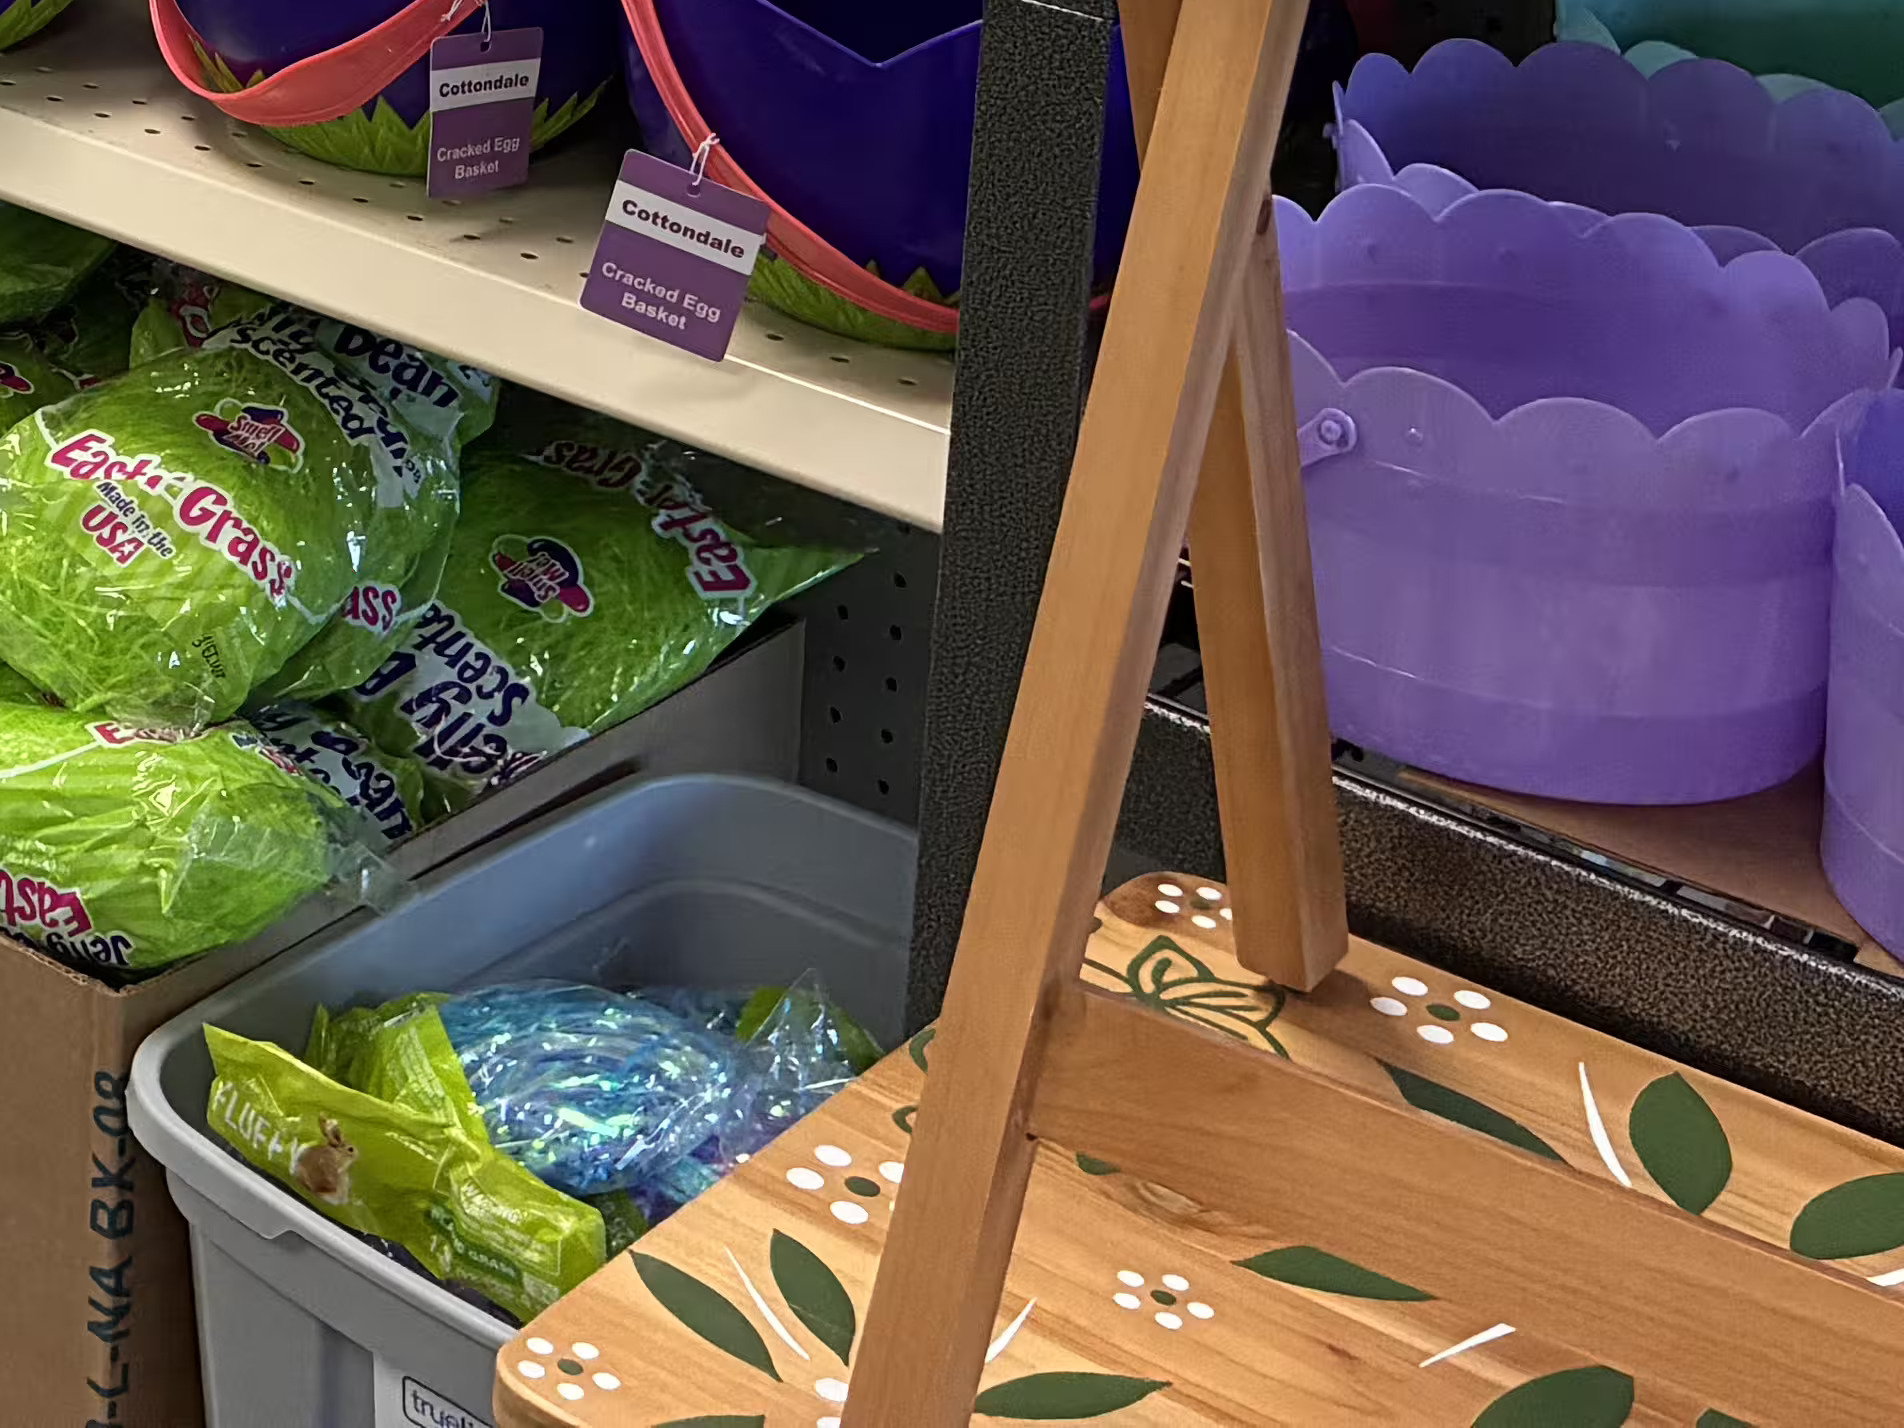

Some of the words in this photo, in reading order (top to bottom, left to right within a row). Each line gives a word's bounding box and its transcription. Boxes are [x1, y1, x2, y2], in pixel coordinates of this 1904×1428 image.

[439, 72, 529, 98] Cottondale
[436, 142, 491, 162] Cracked
[494, 136, 520, 154] Egg
[454, 159, 500, 180] Basket
[621, 199, 745, 260] Cottondale
[601, 262, 680, 303] Cracked
[683, 293, 722, 324] Egg
[620, 291, 687, 330] Basket
[82, 504, 145, 565] USA
[98, 480, 134, 520] Made
[147, 529, 174, 557] the
[179, 485, 293, 602] Grass
